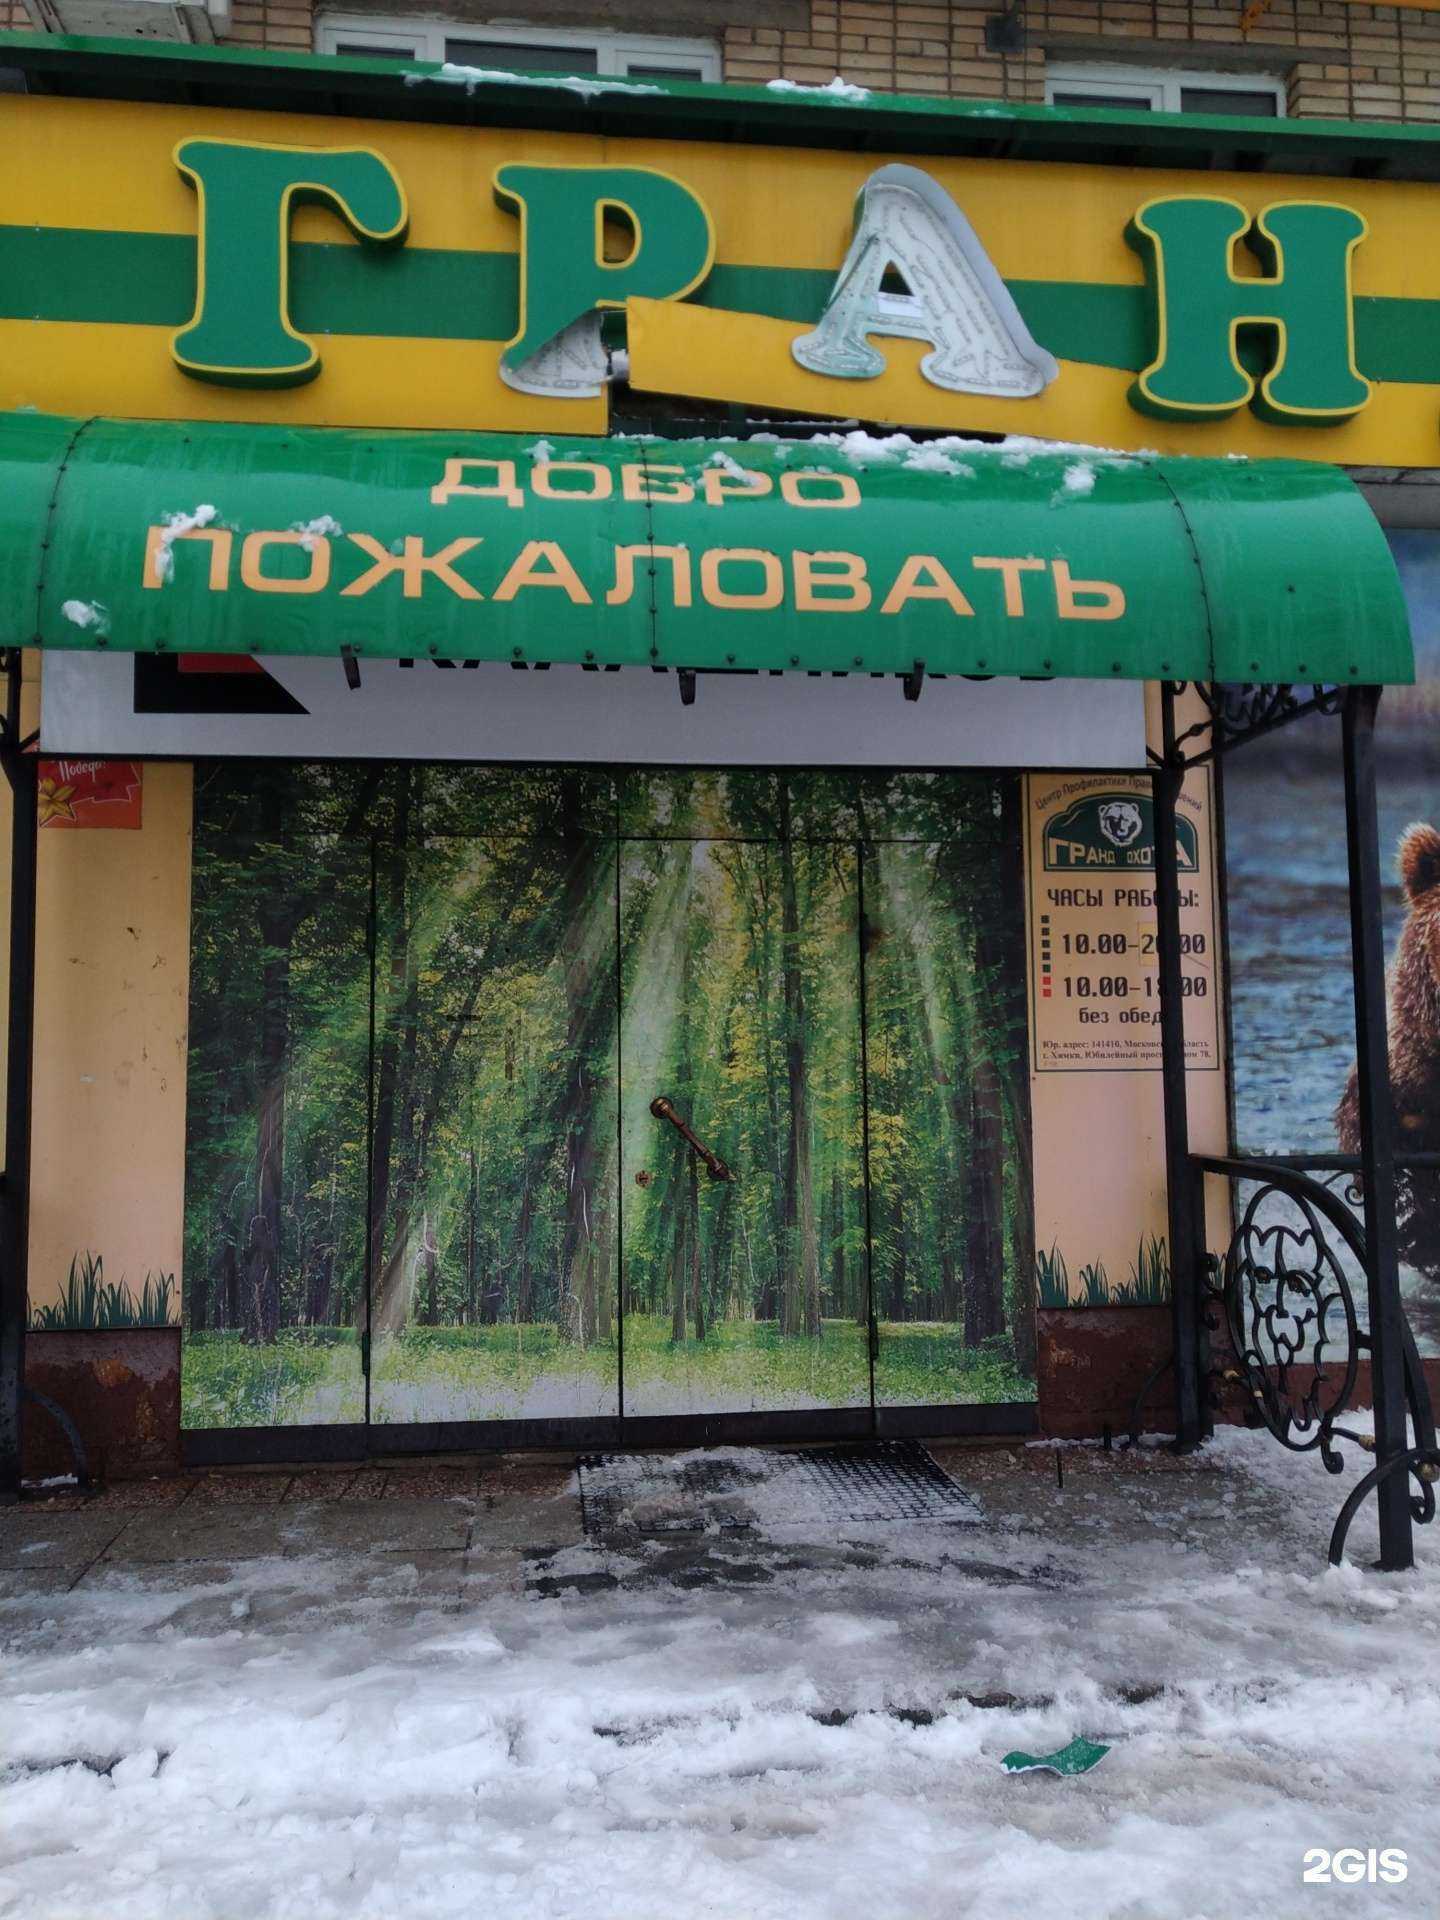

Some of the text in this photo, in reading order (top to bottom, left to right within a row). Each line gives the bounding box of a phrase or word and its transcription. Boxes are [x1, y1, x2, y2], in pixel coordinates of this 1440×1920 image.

[169, 134, 1374, 428] ГРАН
[430, 457, 862, 507] ДОБРО
[142, 525, 1127, 621] ПОЖАЛОВАТЬ
[1034, 788, 1062, 810] Центр
[1127, 839, 1193, 866] ОХОА
[1047, 888, 1200, 908] ЧАСЫ РАБЫ:
[1061, 933, 1206, 955] 10.00-200
[1063, 976, 1207, 997] 10.00-100
[1078, 1006, 1163, 1026] без обед
